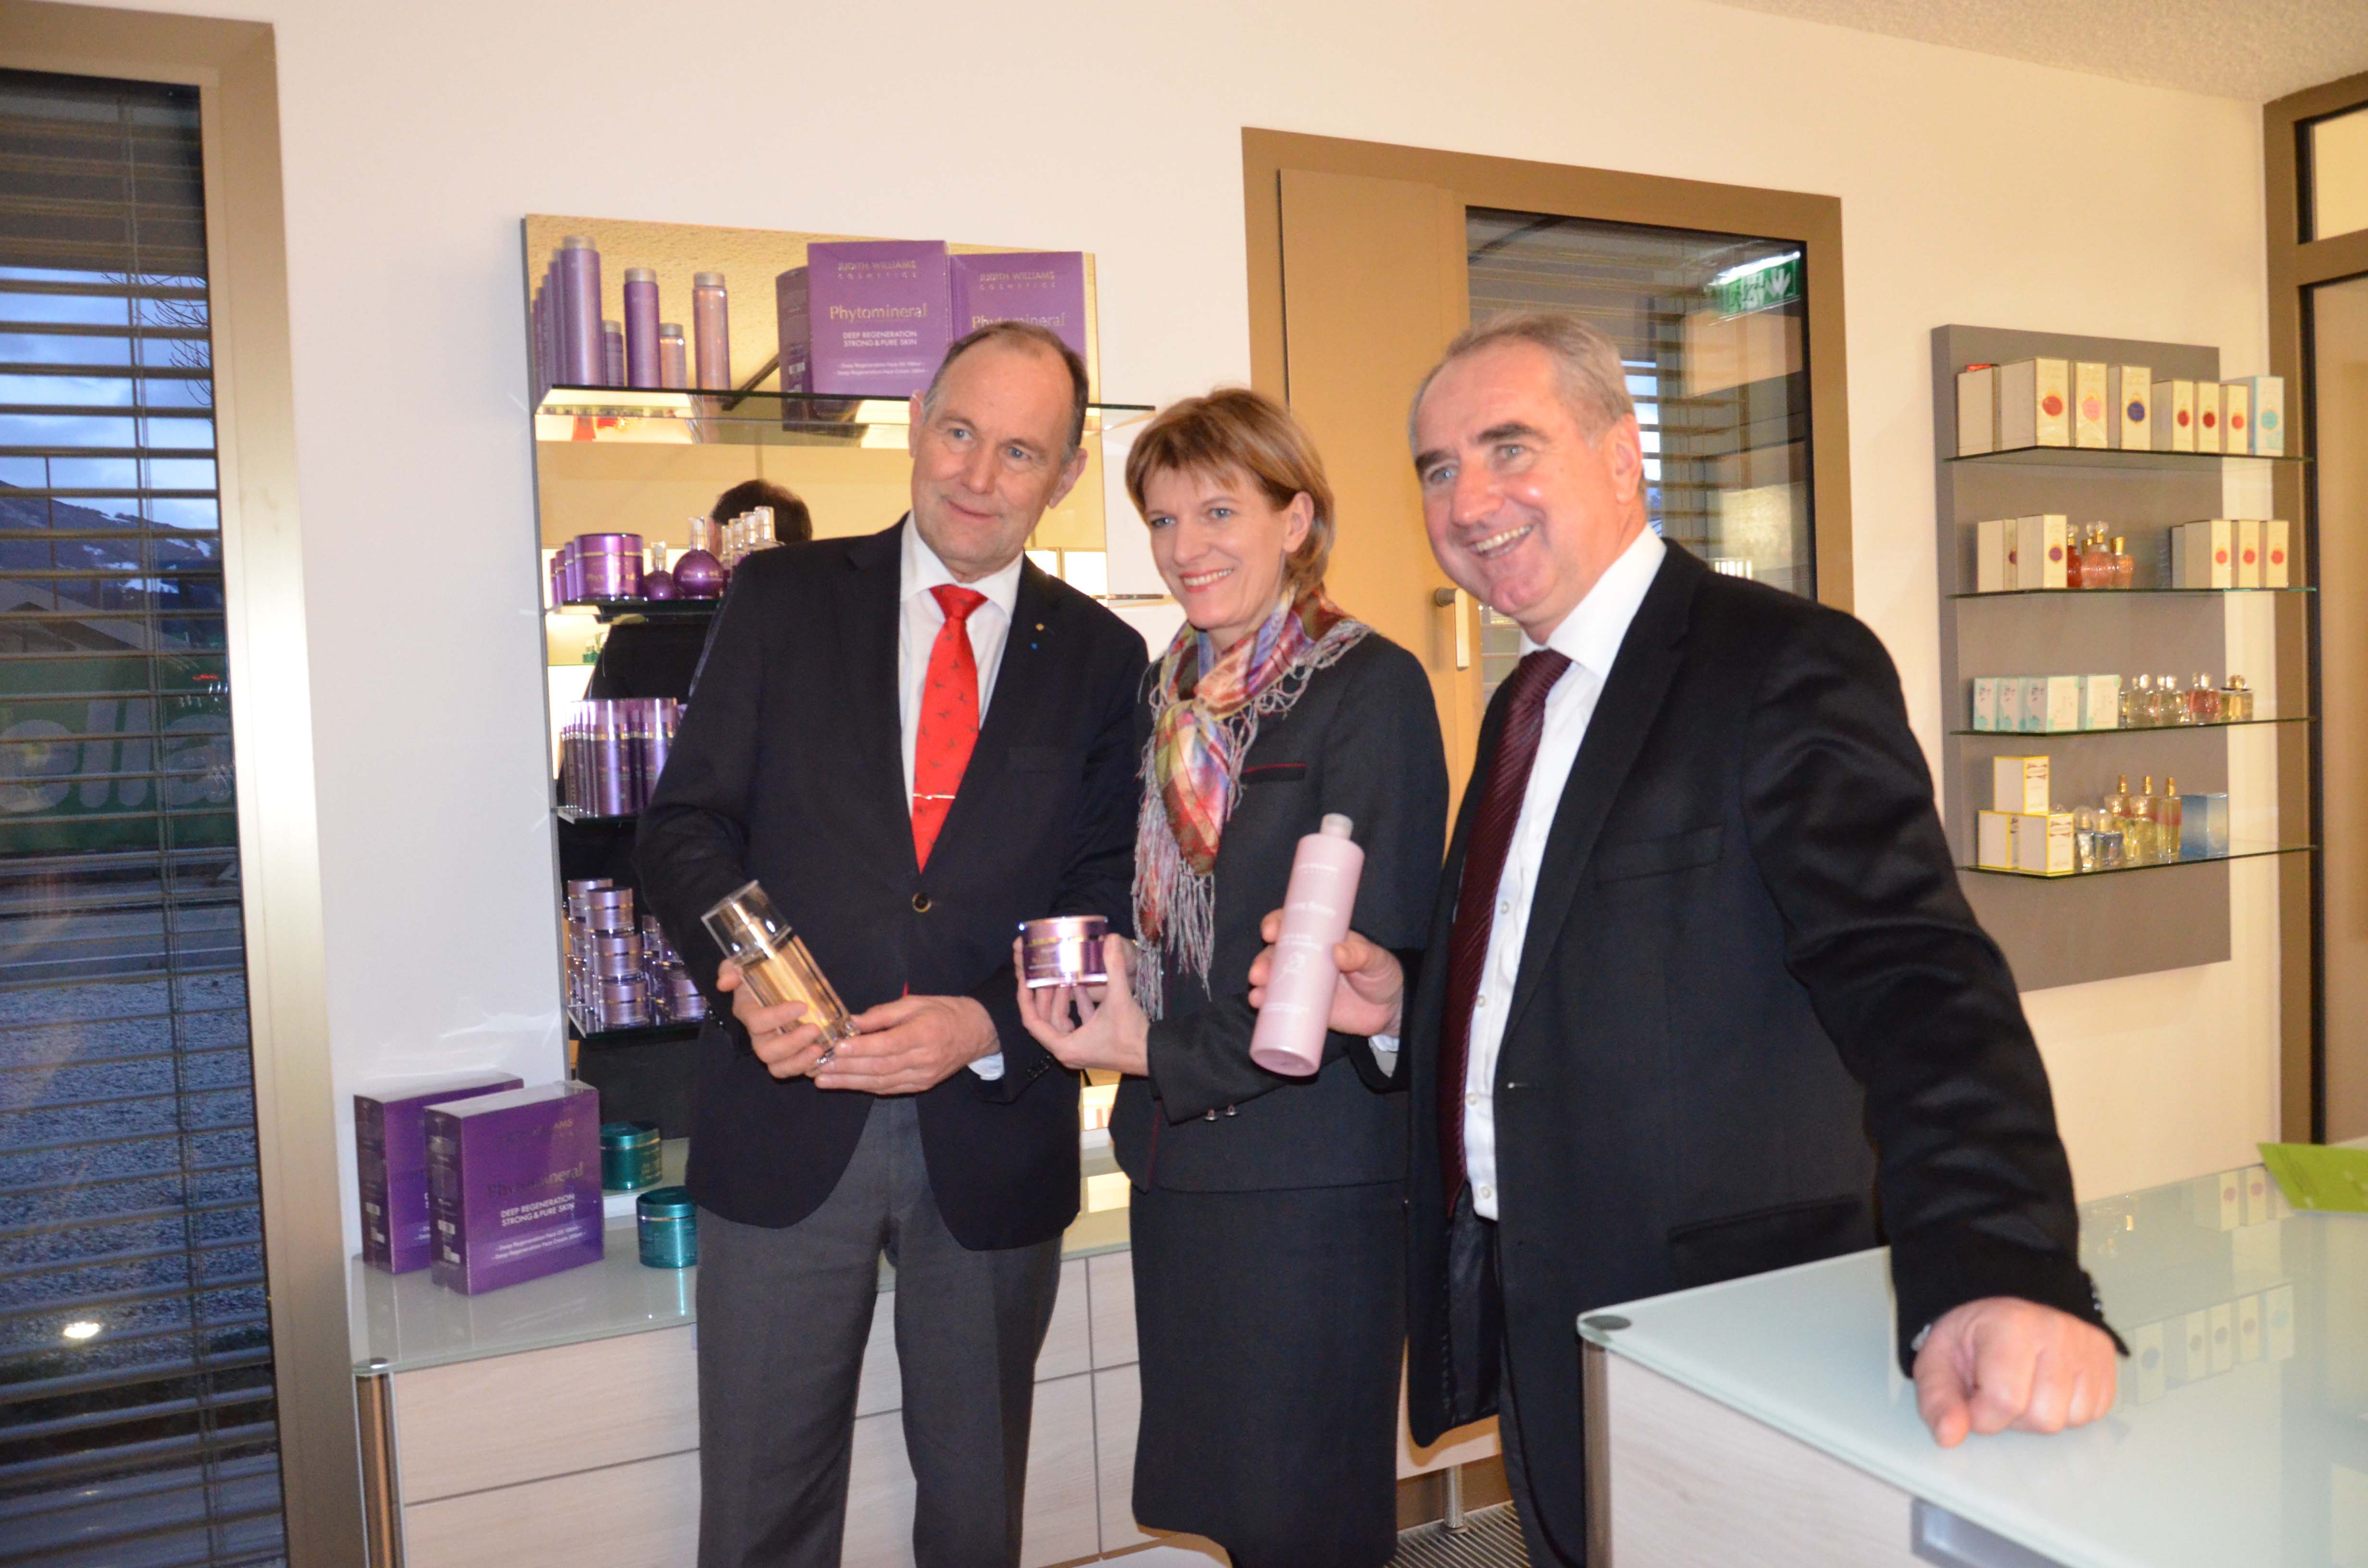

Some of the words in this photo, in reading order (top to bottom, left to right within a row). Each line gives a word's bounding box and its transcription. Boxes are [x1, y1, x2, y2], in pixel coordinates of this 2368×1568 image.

[872, 260, 916, 270] WILLIAMS
[980, 272, 1010, 281] JUDITH
[1013, 271, 1055, 280] WILLIAMS
[830, 303, 927, 323] Phytomineral
[843, 331, 860, 340] DEEP
[843, 339, 874, 347] STRONG
[501, 1207, 519, 1218] DEEP
[521, 1193, 575, 1213] REGENERATION
[502, 1213, 533, 1226] STRONG
[539, 1206, 557, 1217] PURE
[558, 1202, 575, 1212] SKIN
